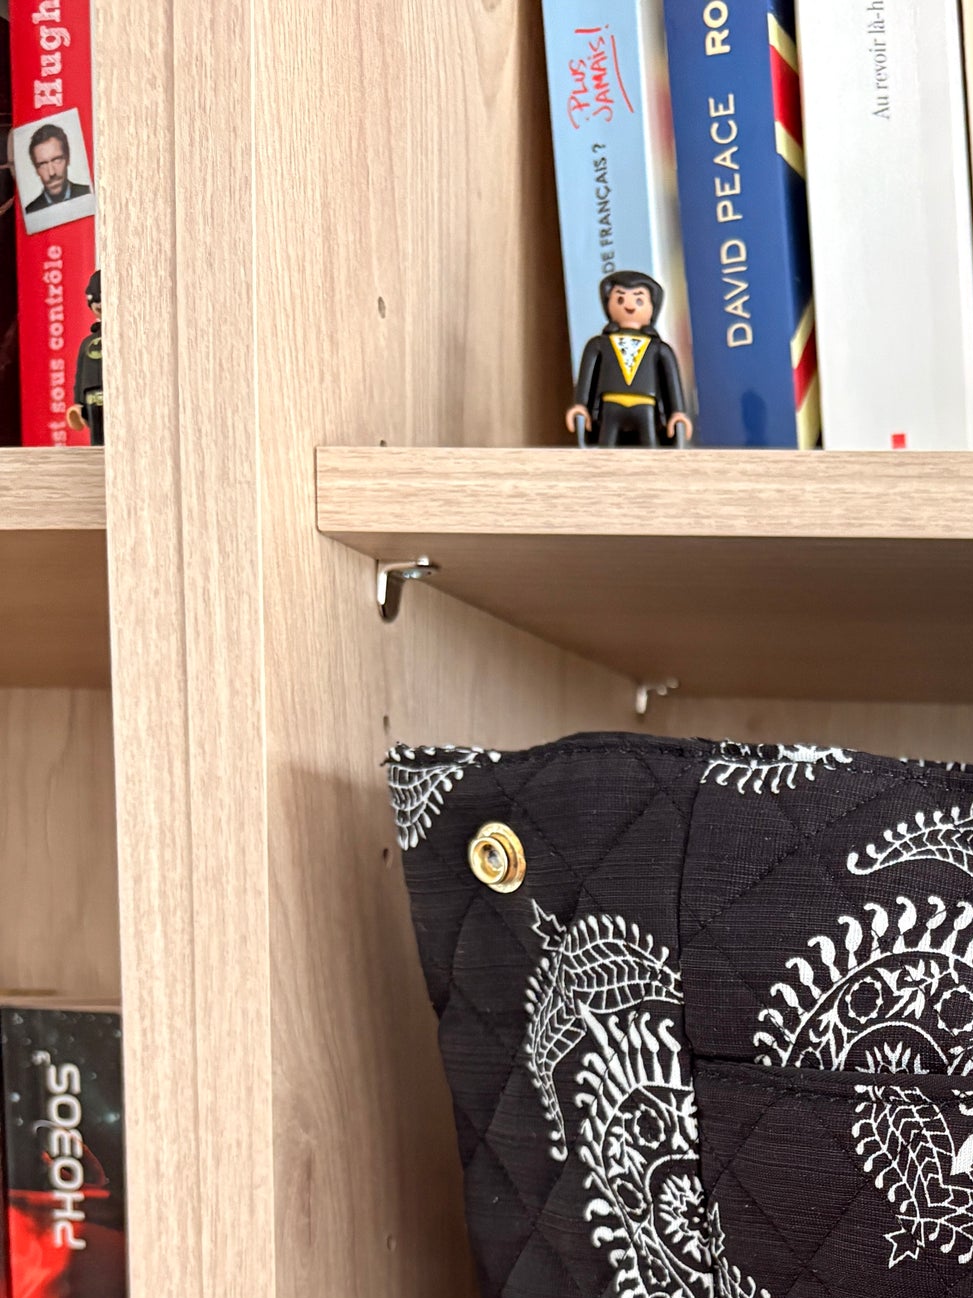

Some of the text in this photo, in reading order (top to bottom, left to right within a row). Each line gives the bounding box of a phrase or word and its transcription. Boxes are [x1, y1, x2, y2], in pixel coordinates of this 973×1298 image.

[32, 0, 71, 109] Hugh
[868, 38, 889, 91] revoir
[872, 96, 891, 120] Au
[593, 156, 614, 248] FRANÇAIS
[708, 93, 753, 348] DAVID PEACE
[42, 245, 65, 351] contrôle
[50, 358, 66, 413] sous
